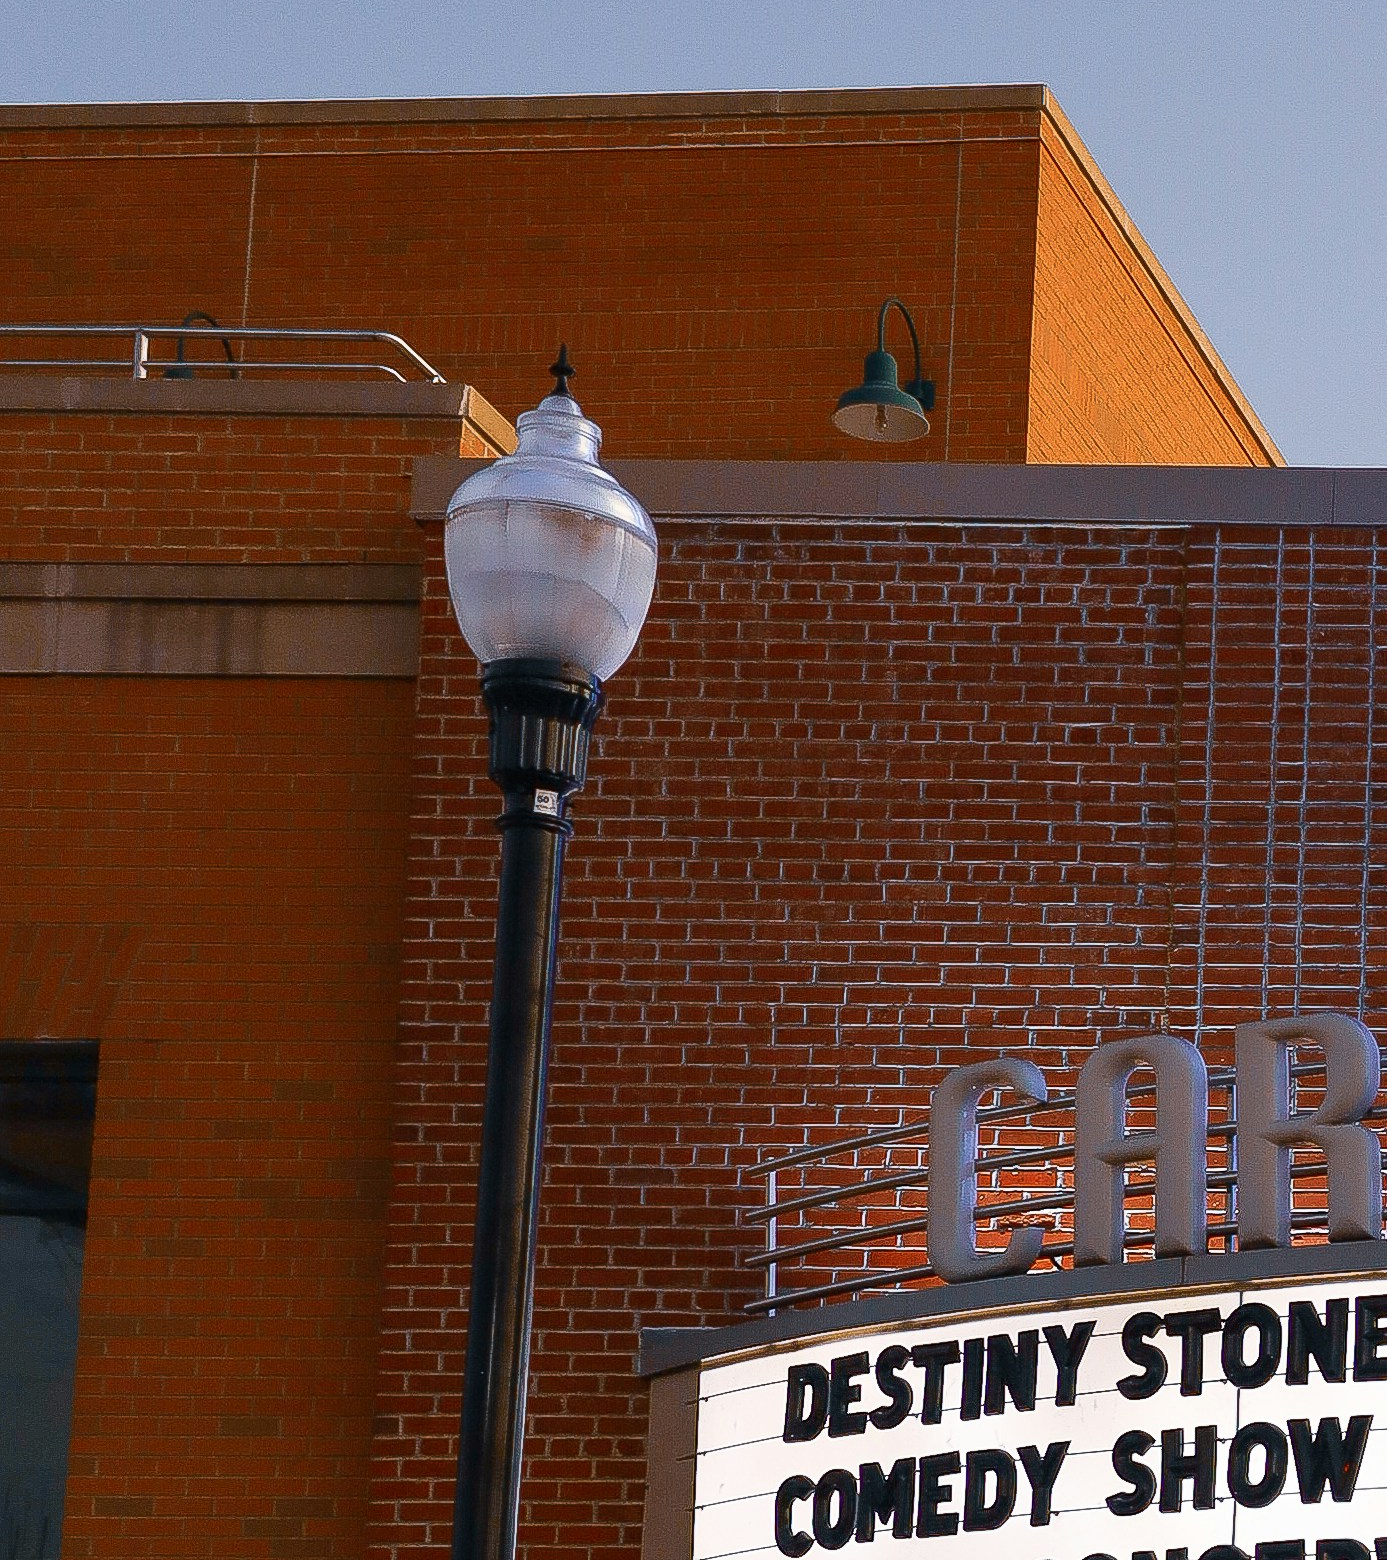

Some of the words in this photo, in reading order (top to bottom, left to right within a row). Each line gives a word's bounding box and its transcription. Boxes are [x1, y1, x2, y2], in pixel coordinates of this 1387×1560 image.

[783, 1321, 1098, 1445] DESTINY
[774, 1441, 1072, 1559] COMEDY
[1106, 1414, 1372, 1518] SHOW
